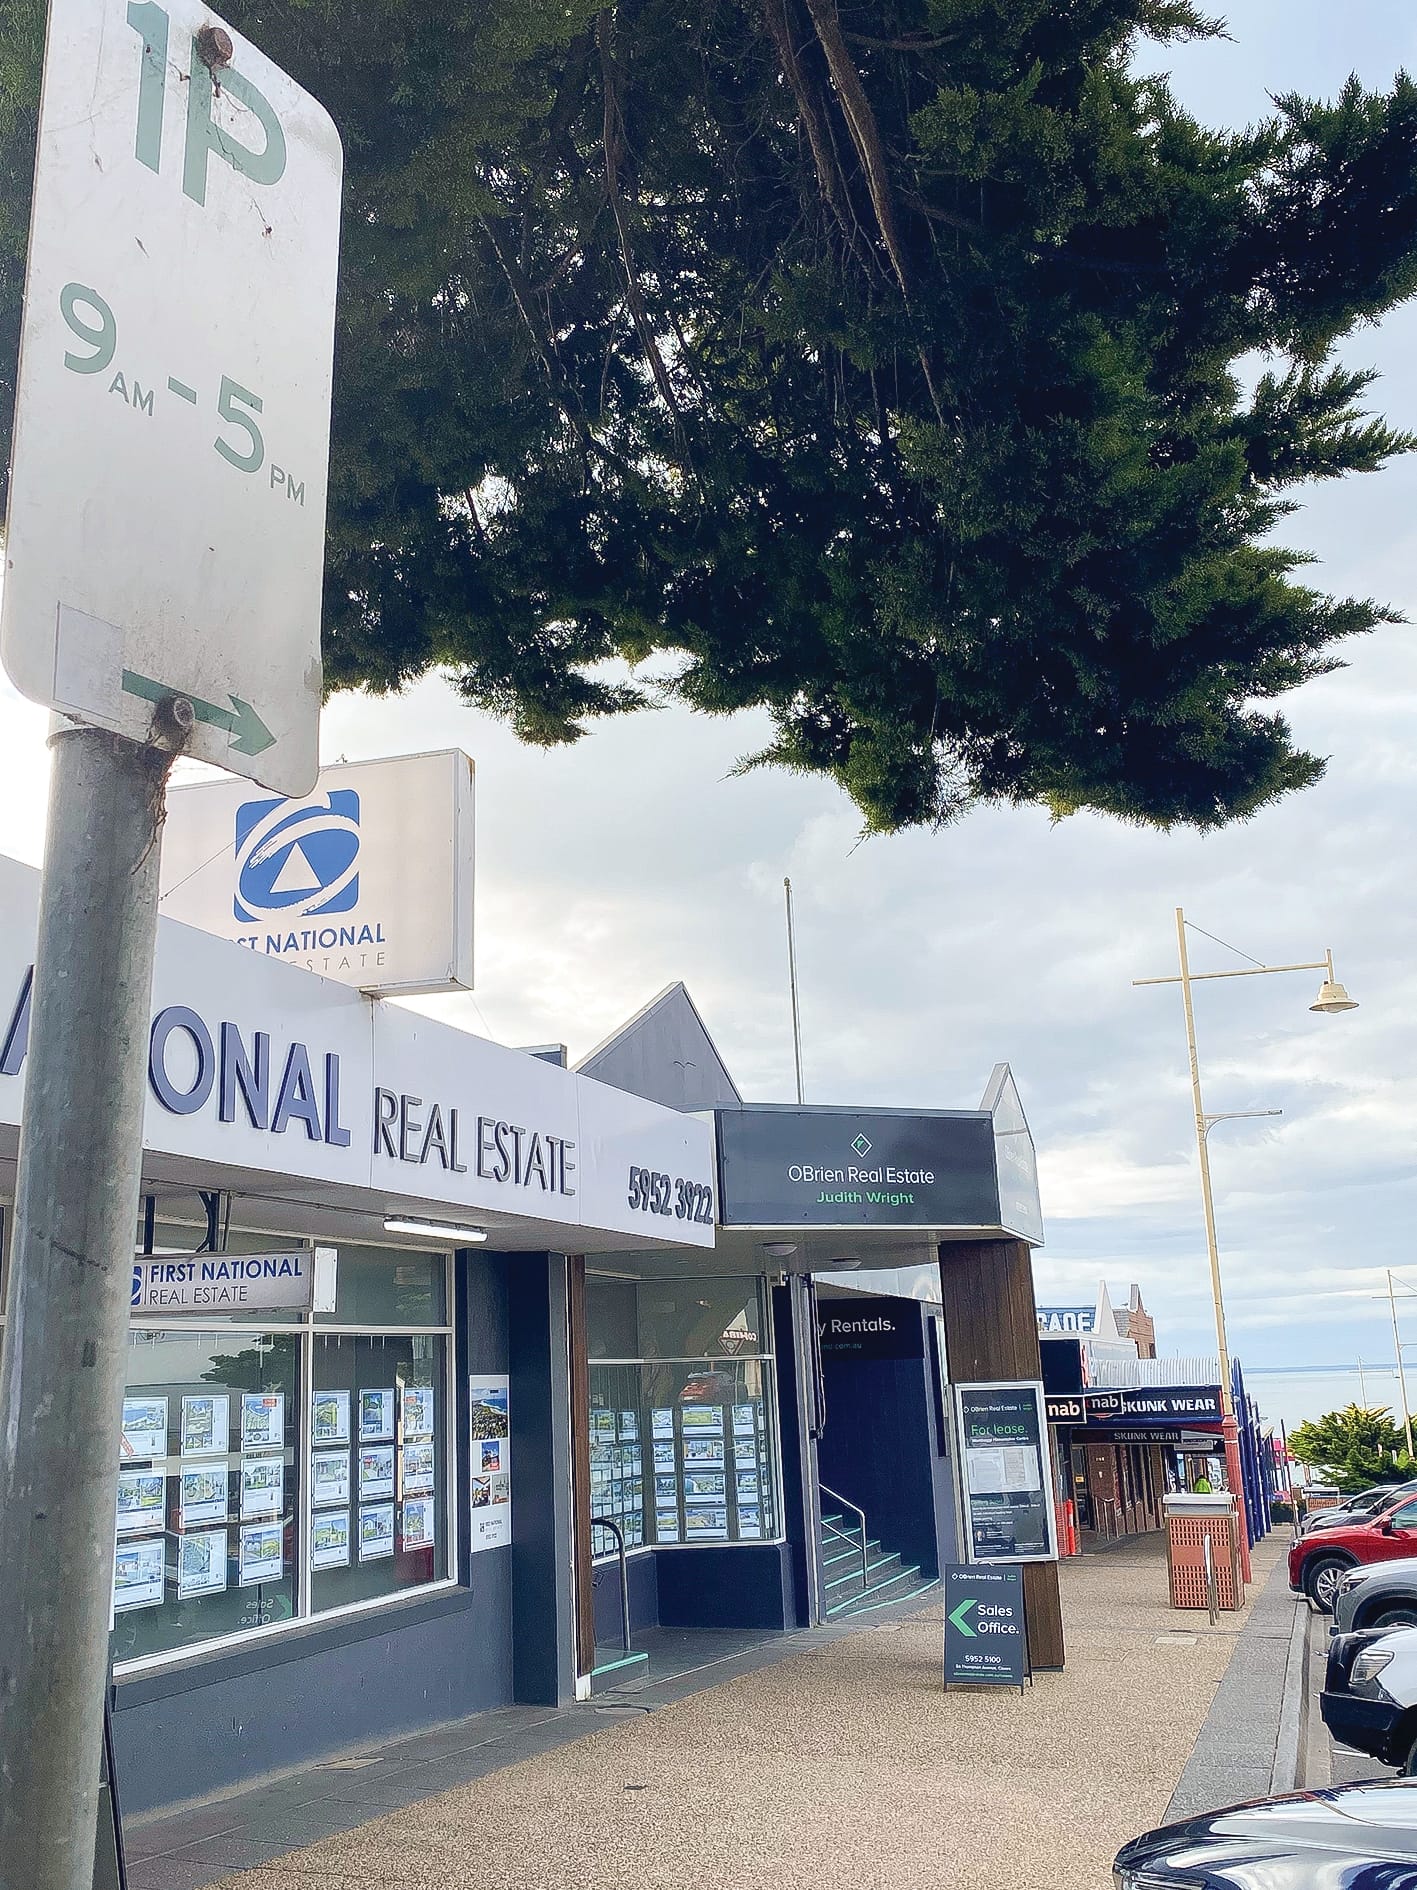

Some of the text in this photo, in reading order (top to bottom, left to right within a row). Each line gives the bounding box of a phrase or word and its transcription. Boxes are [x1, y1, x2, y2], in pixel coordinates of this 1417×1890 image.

[126, 0, 286, 206] 1P
[266, 923, 385, 954] NATIONAL
[373, 1086, 468, 1173] REAL
[477, 1115, 576, 1196] ESTATE
[628, 1165, 672, 1216] 5952
[675, 1178, 713, 1225] 3922
[788, 1165, 935, 1184] OBrien Real Estate
[816, 1191, 914, 1206] Judith Wright
[150, 1257, 303, 1283] FIRST NATIONAL
[150, 1285, 248, 1305] REAL ESTATE
[831, 1316, 896, 1333] Rentals.
[1048, 1400, 1081, 1417] nab
[1090, 1393, 1119, 1409] nab
[1121, 1398, 1216, 1413] SKUNK WEAR
[971, 1423, 1028, 1436] For lease.
[1114, 1432, 1179, 1440] SKUNK WEAR
[977, 1604, 1013, 1617] Sales
[977, 1621, 1020, 1634] Office.
[964, 1654, 1002, 1663] 5952 5100
